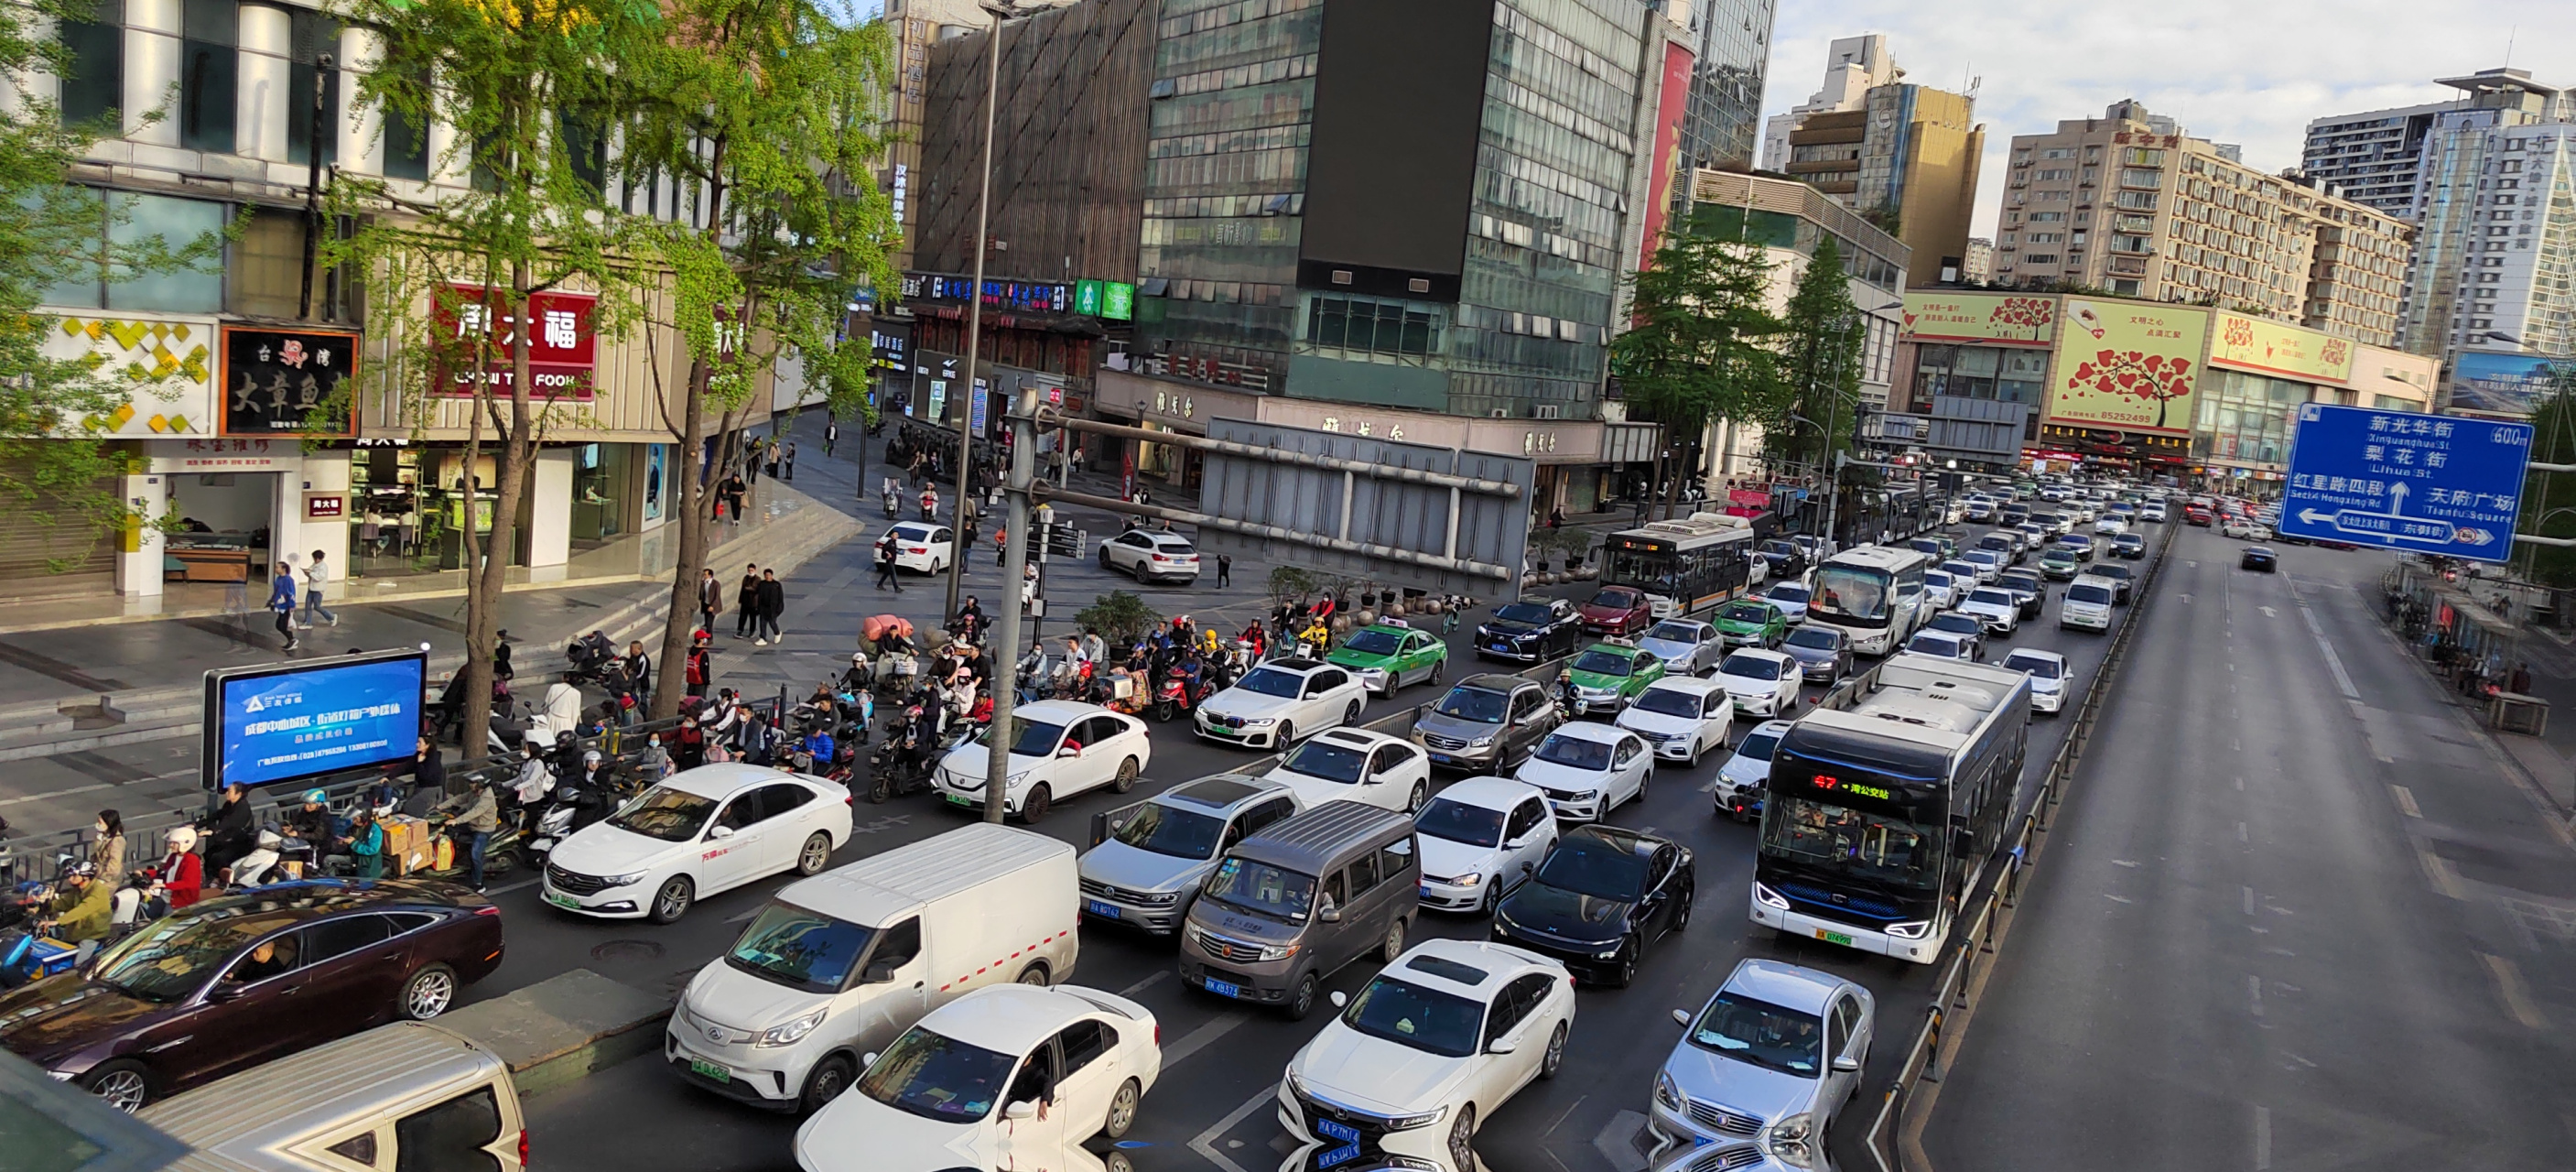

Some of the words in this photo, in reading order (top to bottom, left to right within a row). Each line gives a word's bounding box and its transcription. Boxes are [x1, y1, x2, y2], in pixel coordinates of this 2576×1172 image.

[907, 19, 925, 103] 初品酒店
[2129, 316, 2164, 326] 文明之心
[2146, 329, 2181, 339] 点滴汇聚
[233, 370, 346, 418] 大章鱼
[2101, 411, 2151, 423] 85252499
[2369, 415, 2455, 439] 新光华街
[2364, 444, 2449, 469] 梨花街
[2291, 472, 2386, 496] 红星路四段
[2425, 486, 2516, 512] 天府广场
[2464, 510, 2512, 524] Square
